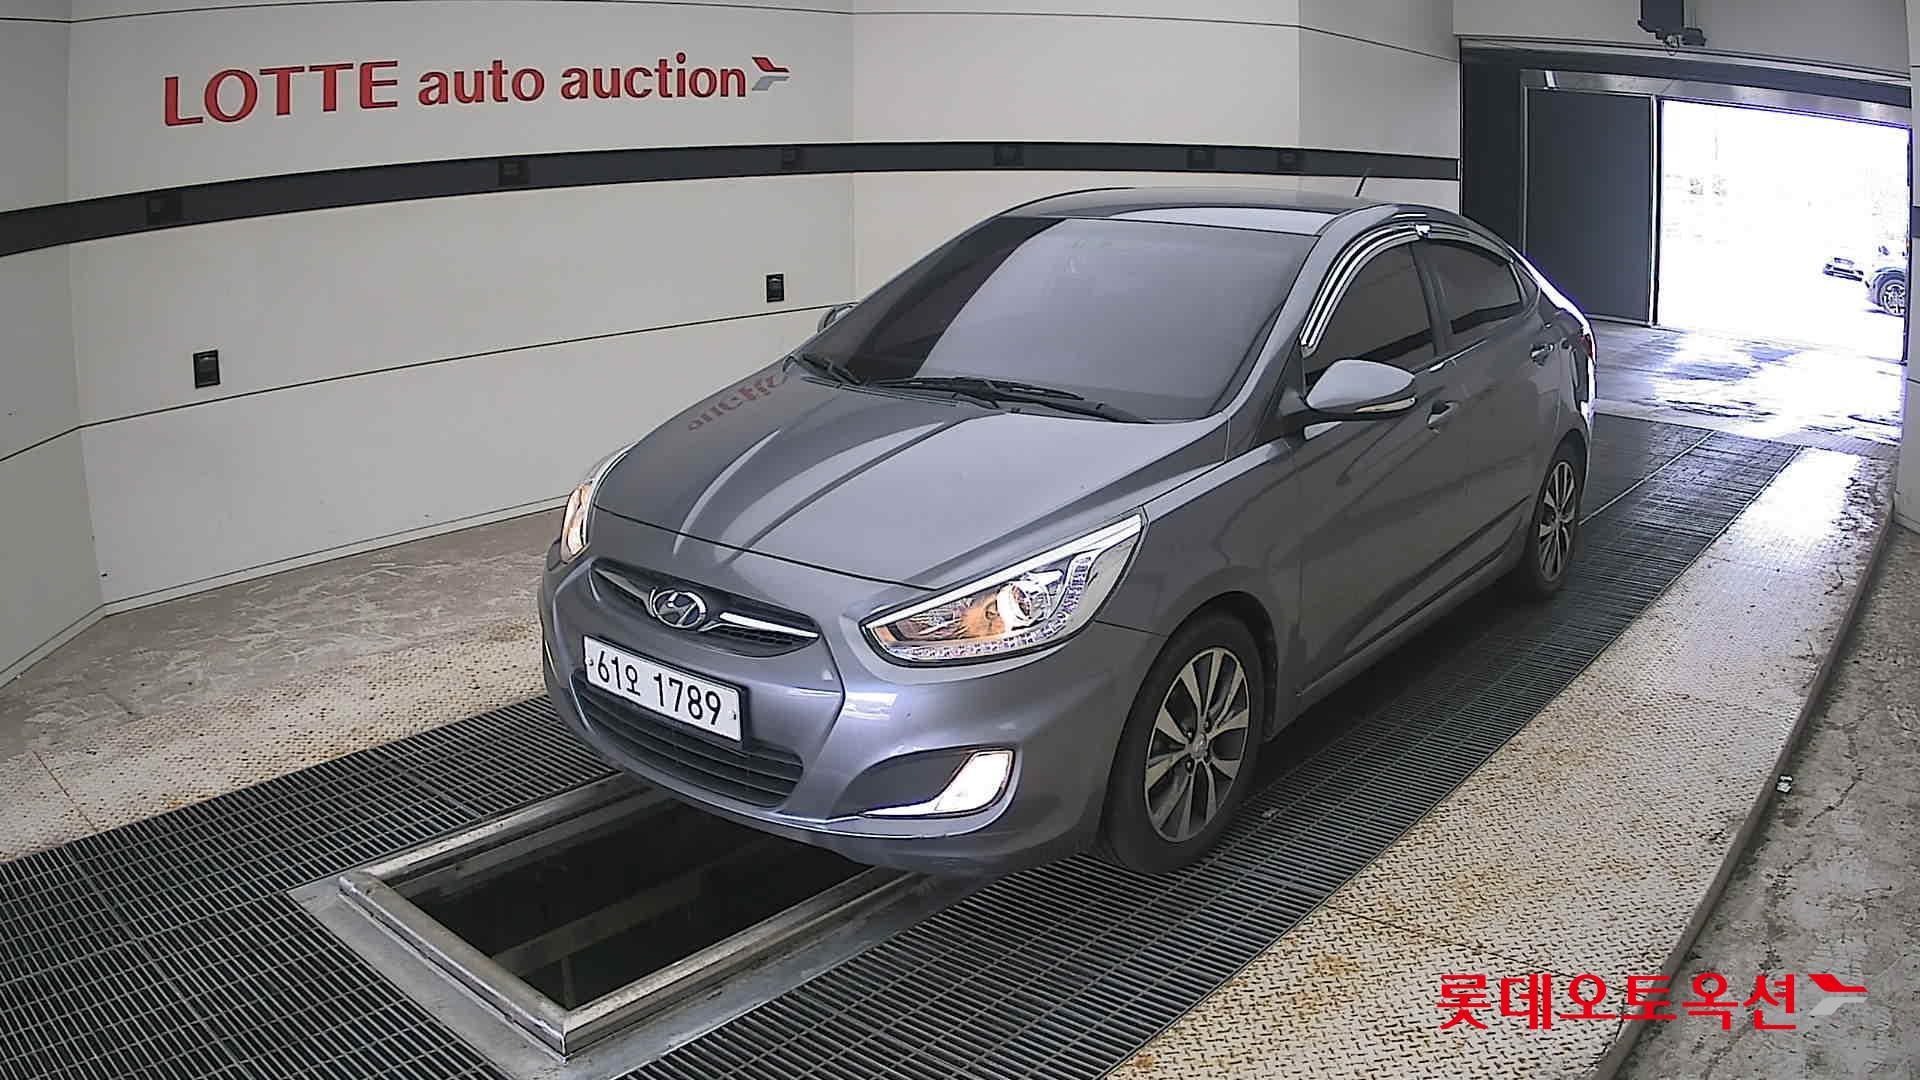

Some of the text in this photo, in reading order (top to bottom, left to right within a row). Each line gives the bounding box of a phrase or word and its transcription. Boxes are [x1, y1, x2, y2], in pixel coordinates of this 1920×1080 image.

[164, 52, 748, 127] LOTTE auto auction
[597, 650, 722, 726] 61오 1789
